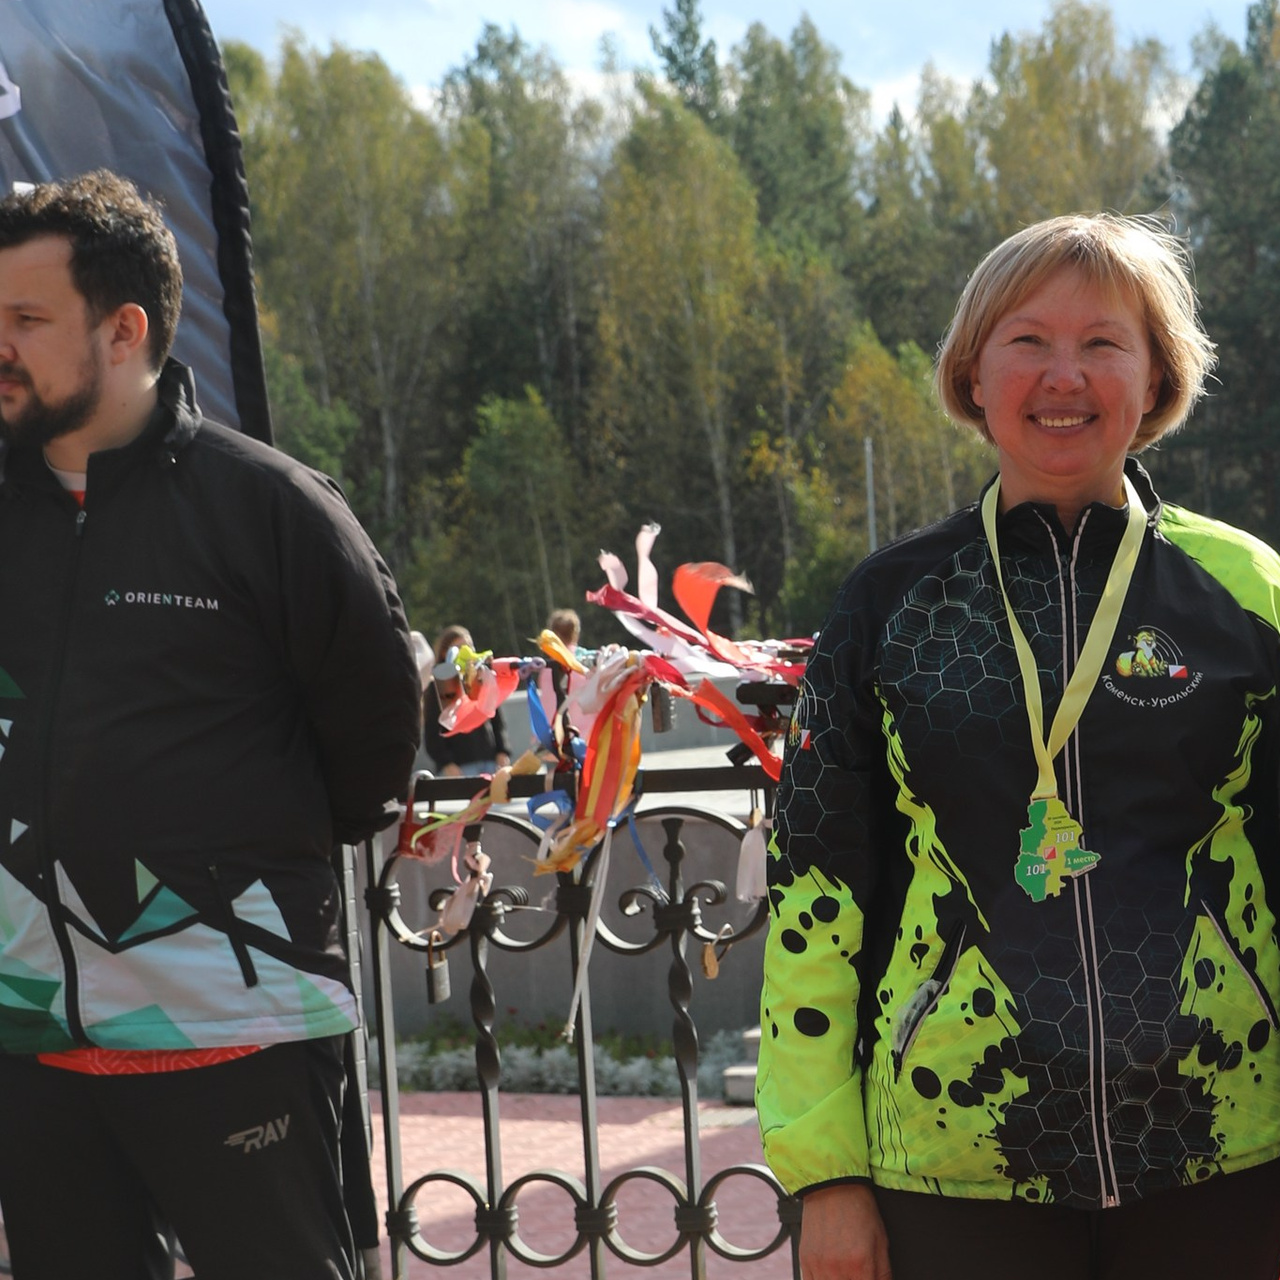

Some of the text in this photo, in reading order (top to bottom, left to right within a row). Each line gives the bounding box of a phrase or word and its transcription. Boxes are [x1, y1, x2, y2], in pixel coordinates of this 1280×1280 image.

[125, 591, 219, 610] ORIENTEAM
[1101, 671, 1204, 708] Каменск-Уральский
[1055, 831, 1075, 843] 101
[1067, 855, 1096, 865] 1 место
[1026, 863, 1046, 876] 101
[224, 1114, 291, 1153] RAY
